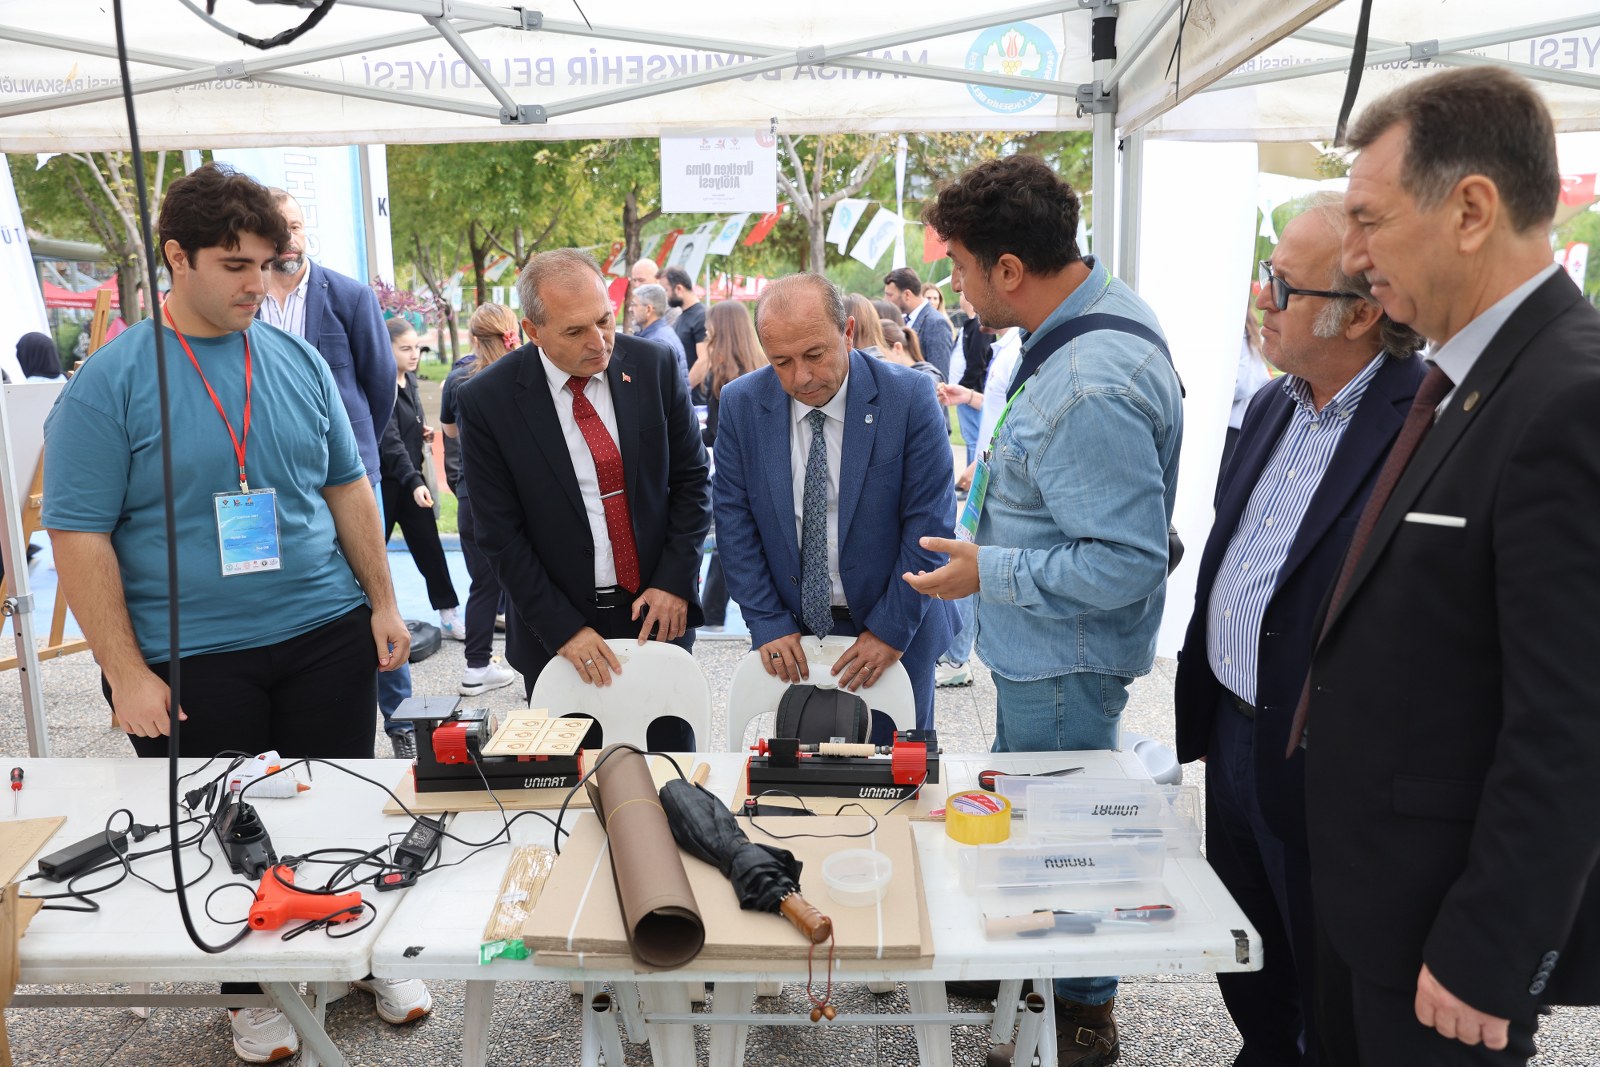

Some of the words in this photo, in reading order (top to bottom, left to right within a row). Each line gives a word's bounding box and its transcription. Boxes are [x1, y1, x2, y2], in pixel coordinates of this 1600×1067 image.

[524, 776, 567, 789] UNIMAT
[859, 787, 904, 799] UNIMAT
[1092, 804, 1139, 817] UNIMAT
